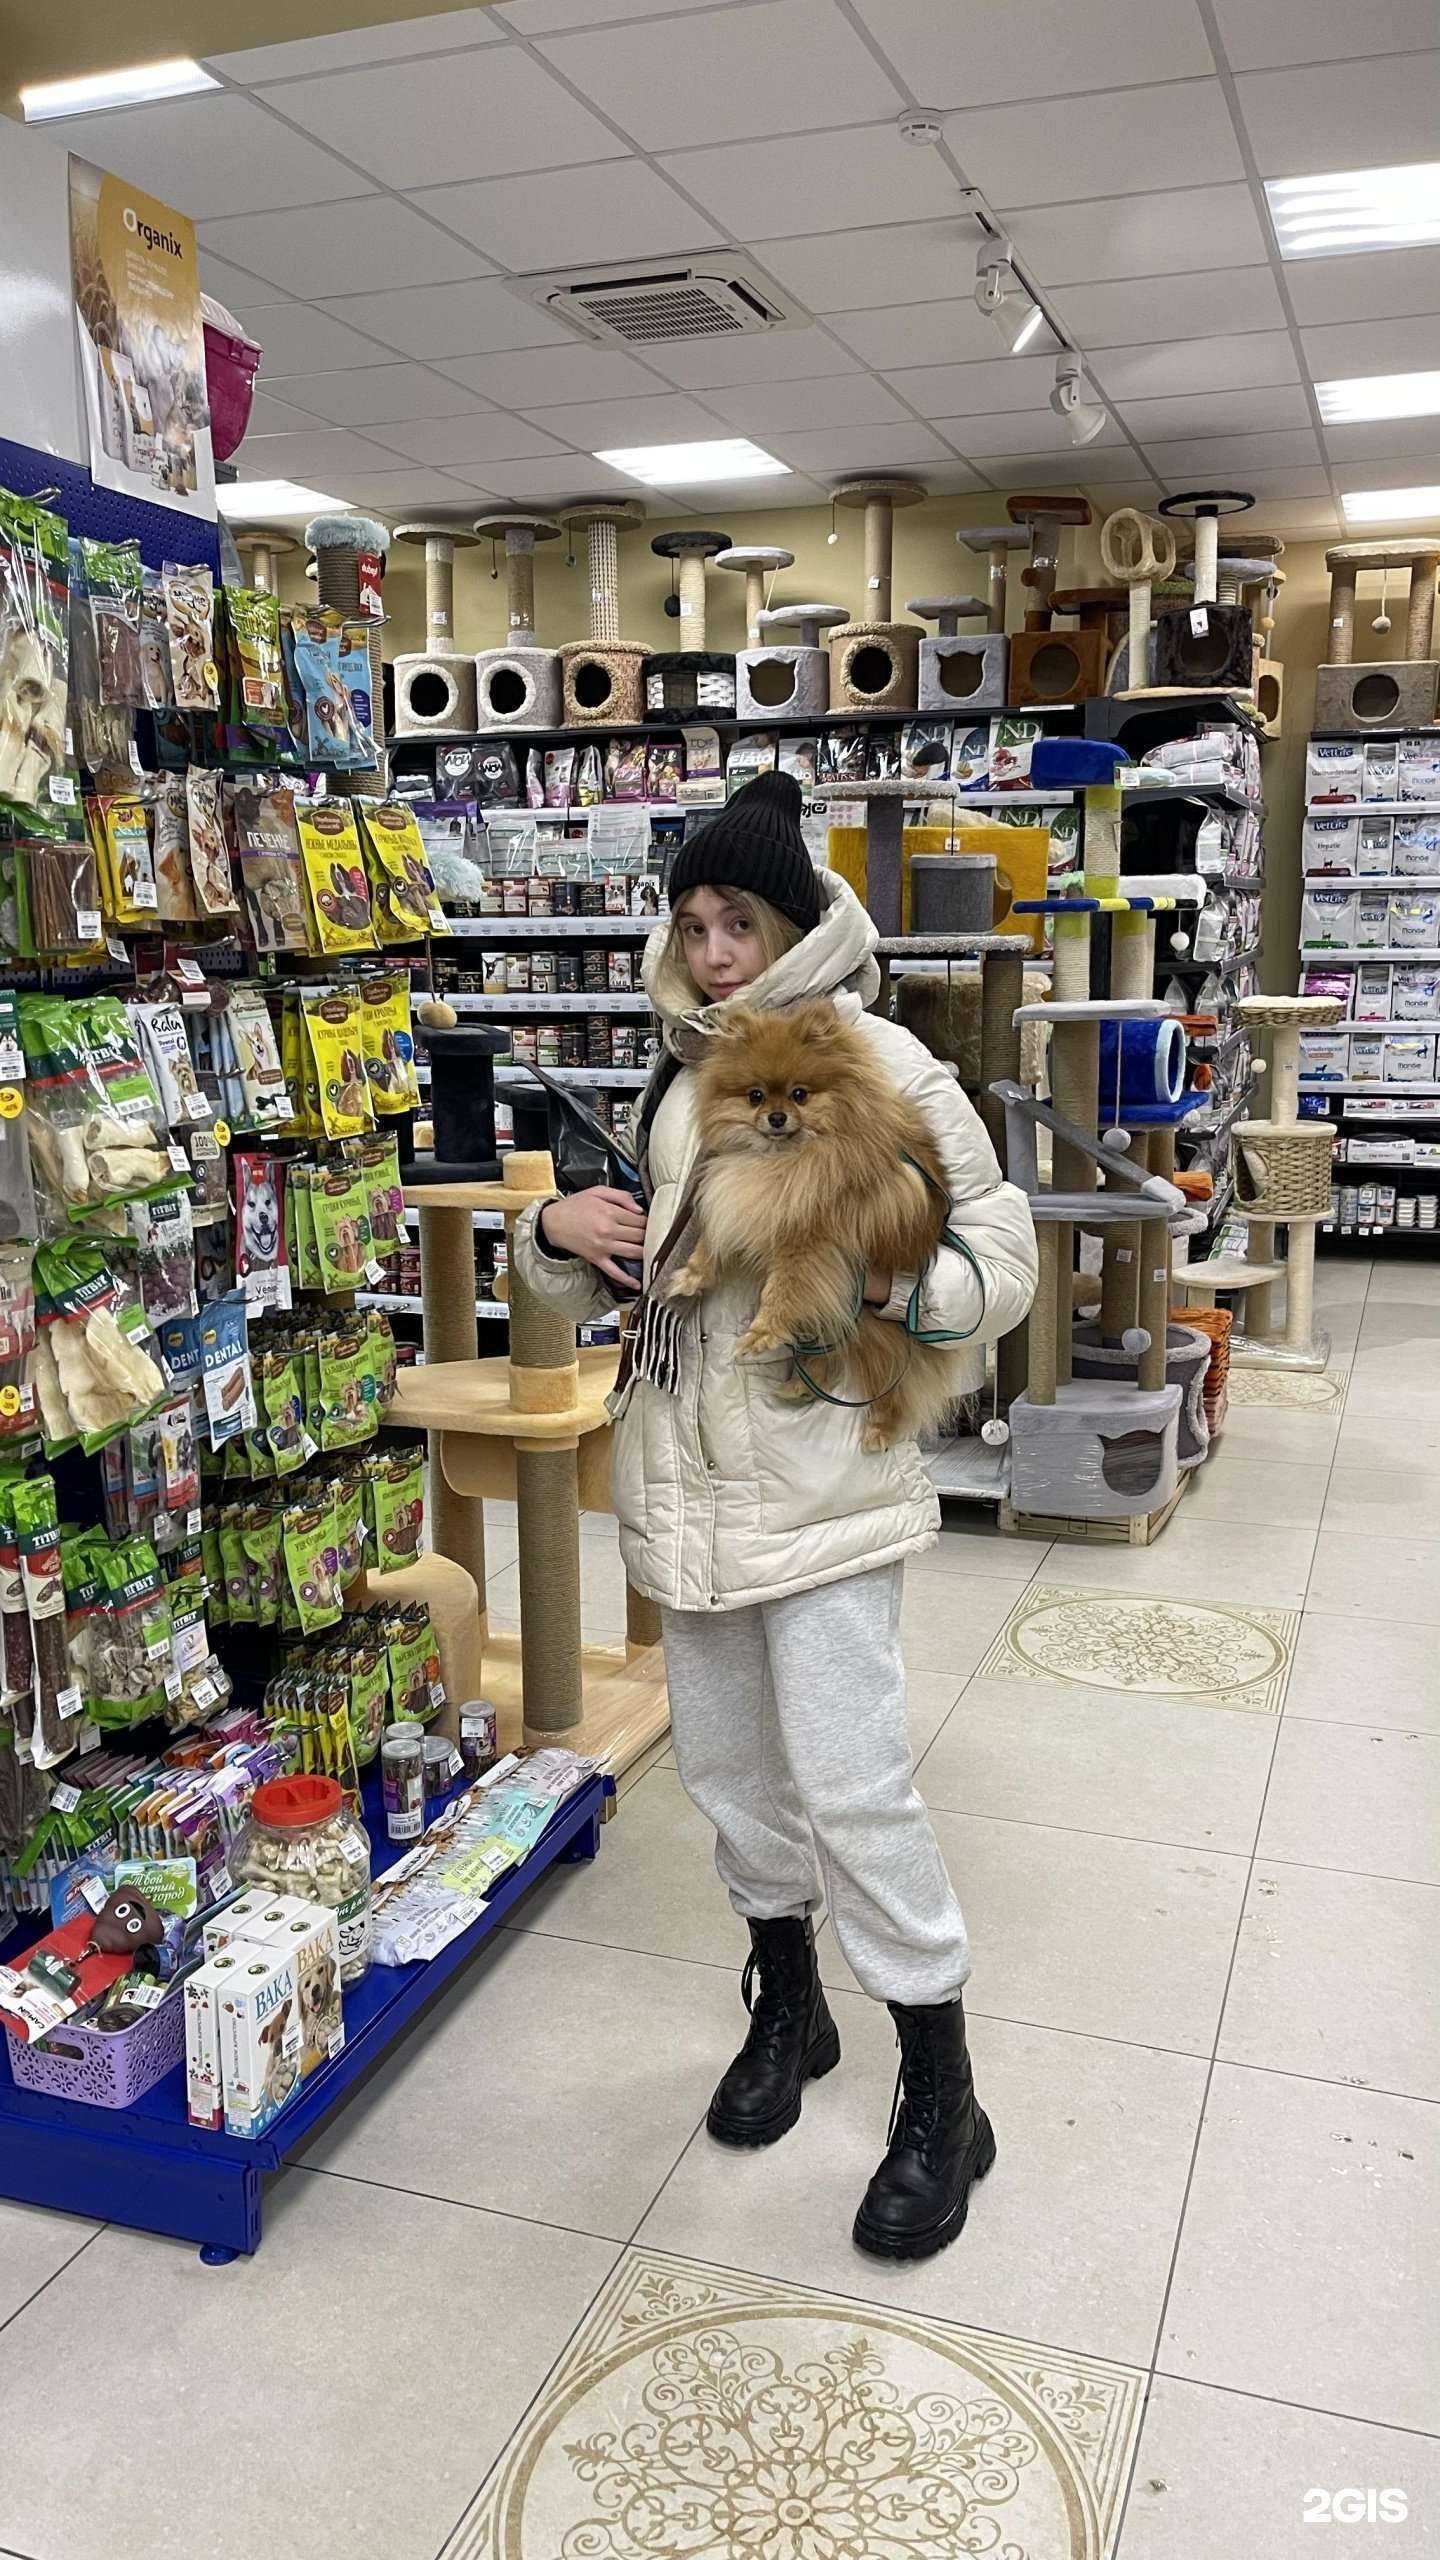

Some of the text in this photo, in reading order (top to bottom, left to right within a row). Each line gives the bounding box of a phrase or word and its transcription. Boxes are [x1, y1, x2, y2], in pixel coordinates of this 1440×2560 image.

[123, 208, 182, 259] Organix
[171, 1348, 200, 1370] DENT
[205, 1339, 243, 1368] DENTAL
[130, 1870, 163, 1886] Твой
[152, 1887, 185, 1905] город
